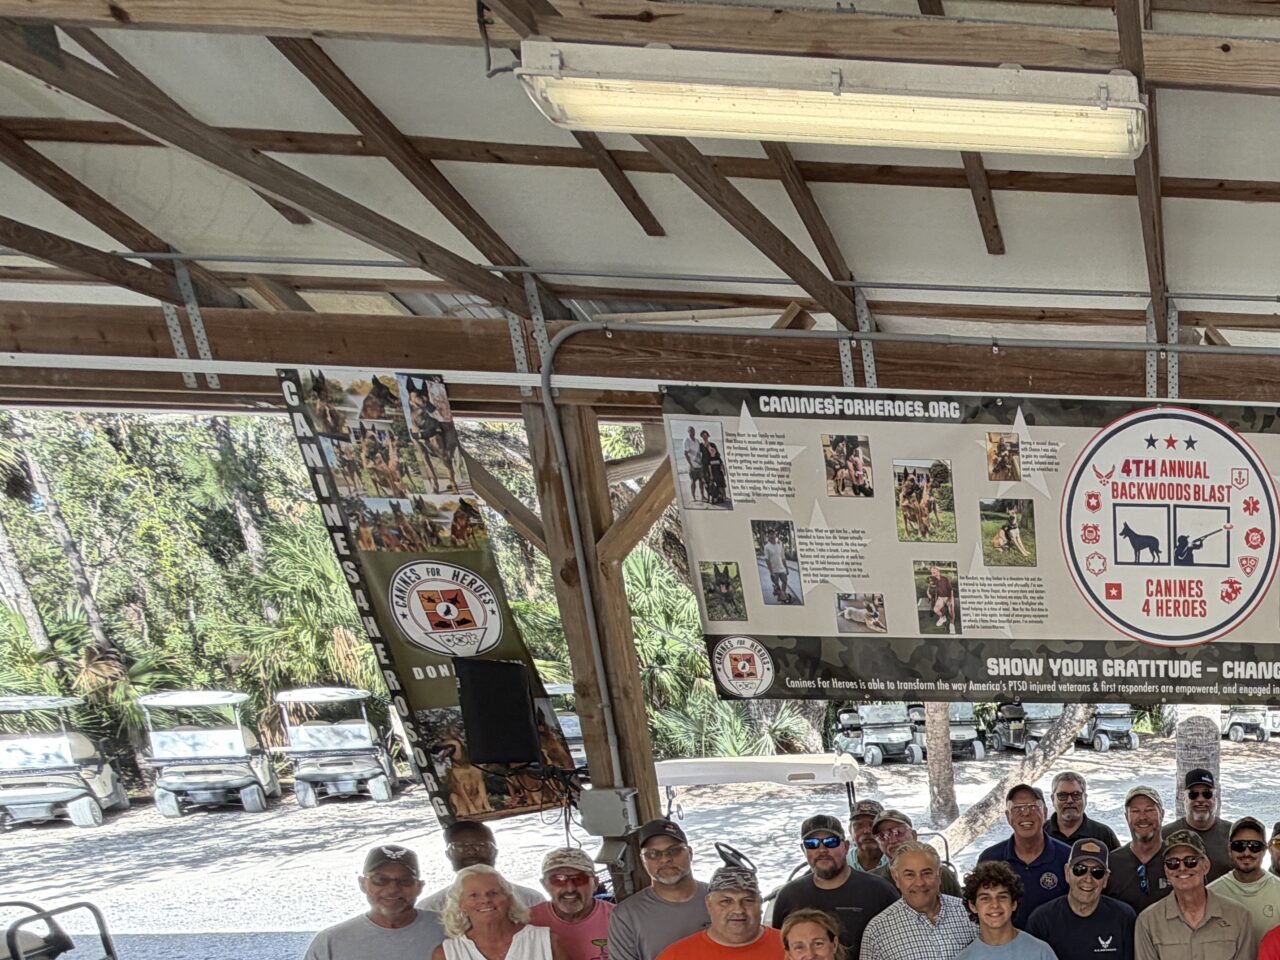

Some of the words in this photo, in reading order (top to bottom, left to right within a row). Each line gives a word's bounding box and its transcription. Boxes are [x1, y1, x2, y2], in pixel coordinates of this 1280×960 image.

[759, 395, 960, 419] CANINESFORHEROES.ORG
[1121, 459, 1156, 478] 4TH
[1160, 461, 1210, 479] ANNUAL
[1111, 482, 1191, 501] BACKWOODS
[1193, 484, 1233, 503] BLAST
[394, 568, 422, 609] CANINES
[425, 567, 442, 577] FOR
[451, 570, 494, 606] HEROES
[1145, 579, 1204, 598] CANINES
[1142, 600, 1151, 617] 4
[1156, 599, 1207, 618] HEROES
[714, 639, 735, 666] CANINES
[750, 640, 770, 667] HEROES
[987, 657, 1044, 676] SHOW
[1048, 658, 1098, 677] YOUR
[1102, 659, 1202, 679] GRATITUDE
[785, 677, 816, 689] Canines
[817, 678, 830, 689] For
[832, 678, 859, 690] Heroes
[859, 679, 866, 690] is
[868, 679, 885, 690] able
[887, 680, 896, 690] to
[896, 679, 936, 691] transform
[937, 680, 950, 690] the
[951, 682, 967, 693] way
[969, 680, 1007, 692] America's
[1008, 681, 1028, 692] PTSD
[1029, 681, 1056, 693] injured
[1058, 682, 1091, 693] veterans
[1092, 682, 1100, 692] &
[1101, 681, 1116, 692] first
[1118, 682, 1159, 695] responders
[1161, 684, 1174, 693] are
[1175, 683, 1221, 696] empowered,
[1222, 683, 1237, 694] and
[1238, 684, 1271, 696] engaged
[1272, 683, 1280, 694] in
